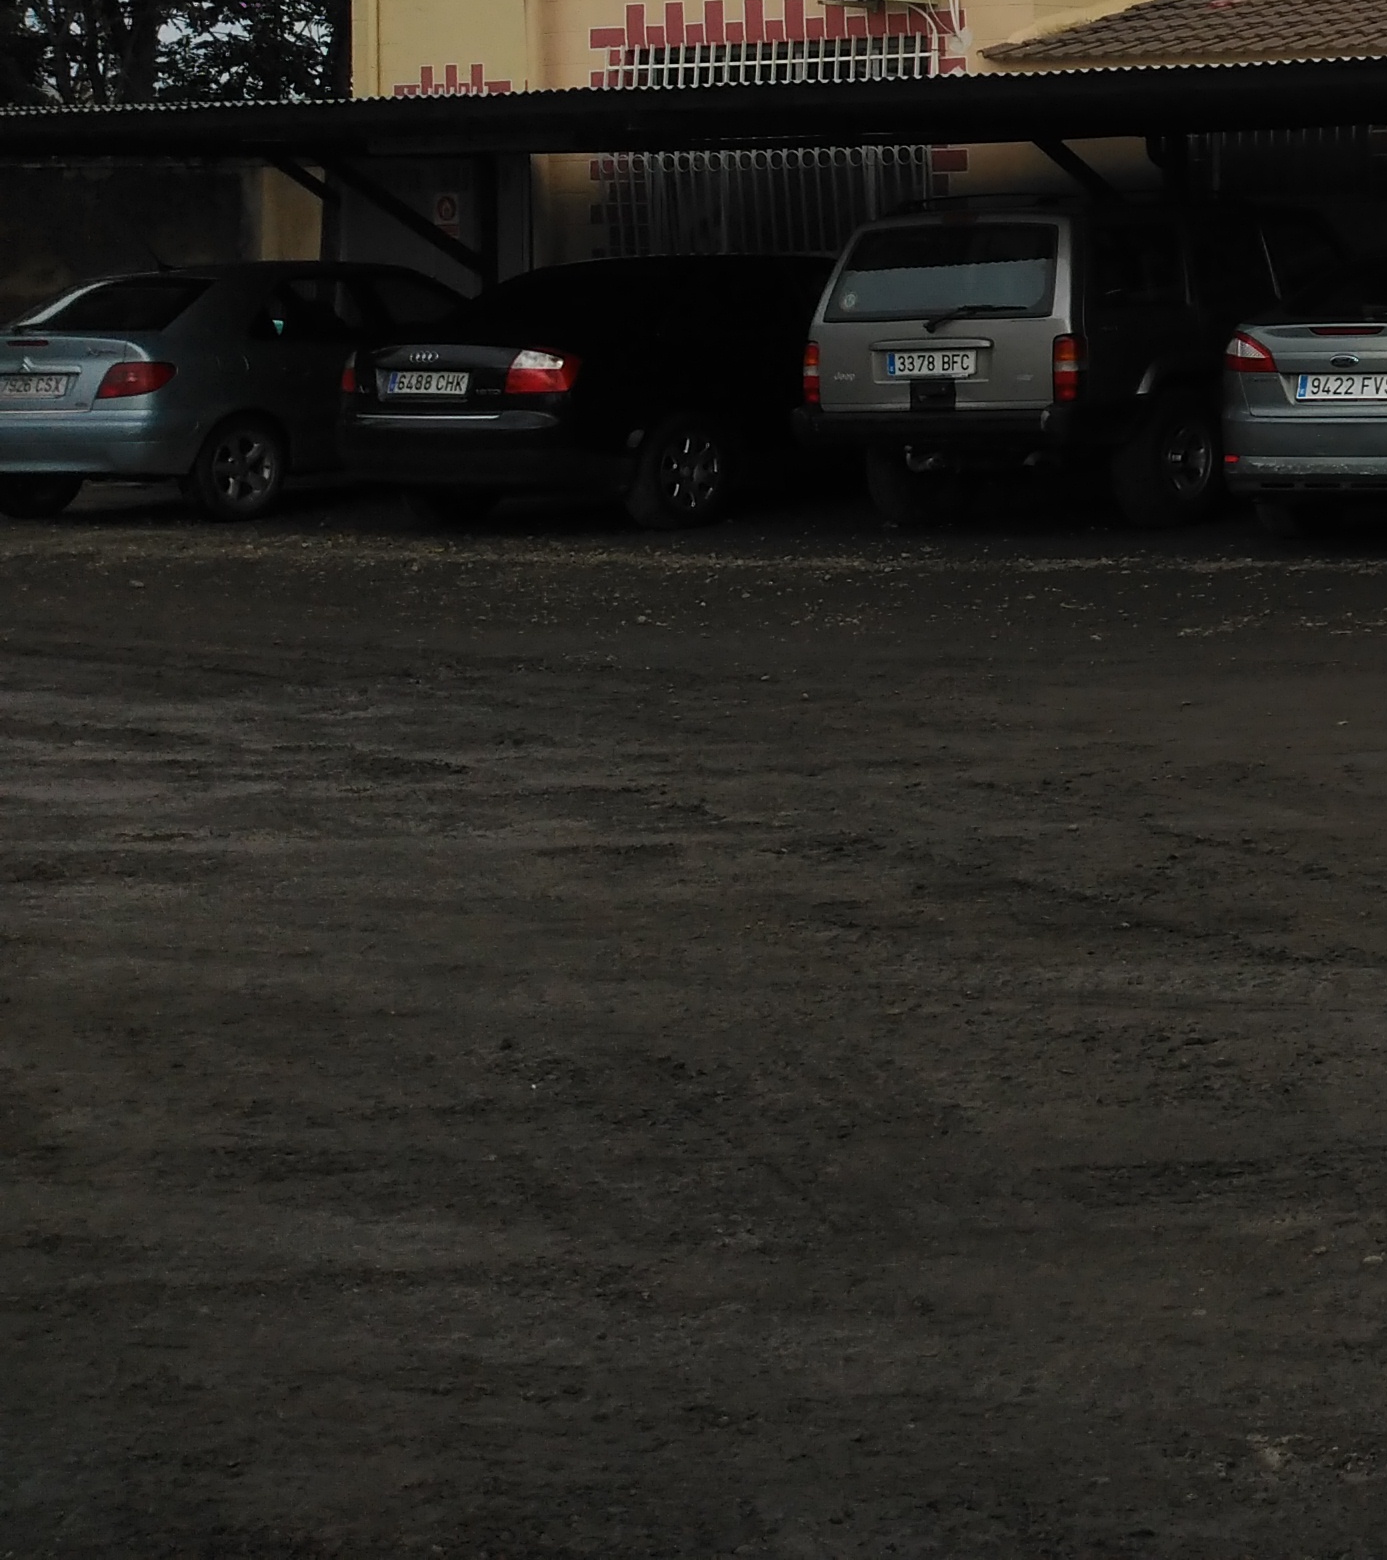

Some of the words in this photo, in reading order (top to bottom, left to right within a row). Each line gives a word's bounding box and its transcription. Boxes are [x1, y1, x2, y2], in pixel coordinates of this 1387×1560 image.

[897, 354, 936, 373] 3378
[941, 353, 970, 371] BFC
[35, 376, 62, 393] CSX
[397, 374, 433, 391] 6488
[436, 374, 465, 392] CHK
[1310, 376, 1355, 396] 9422
